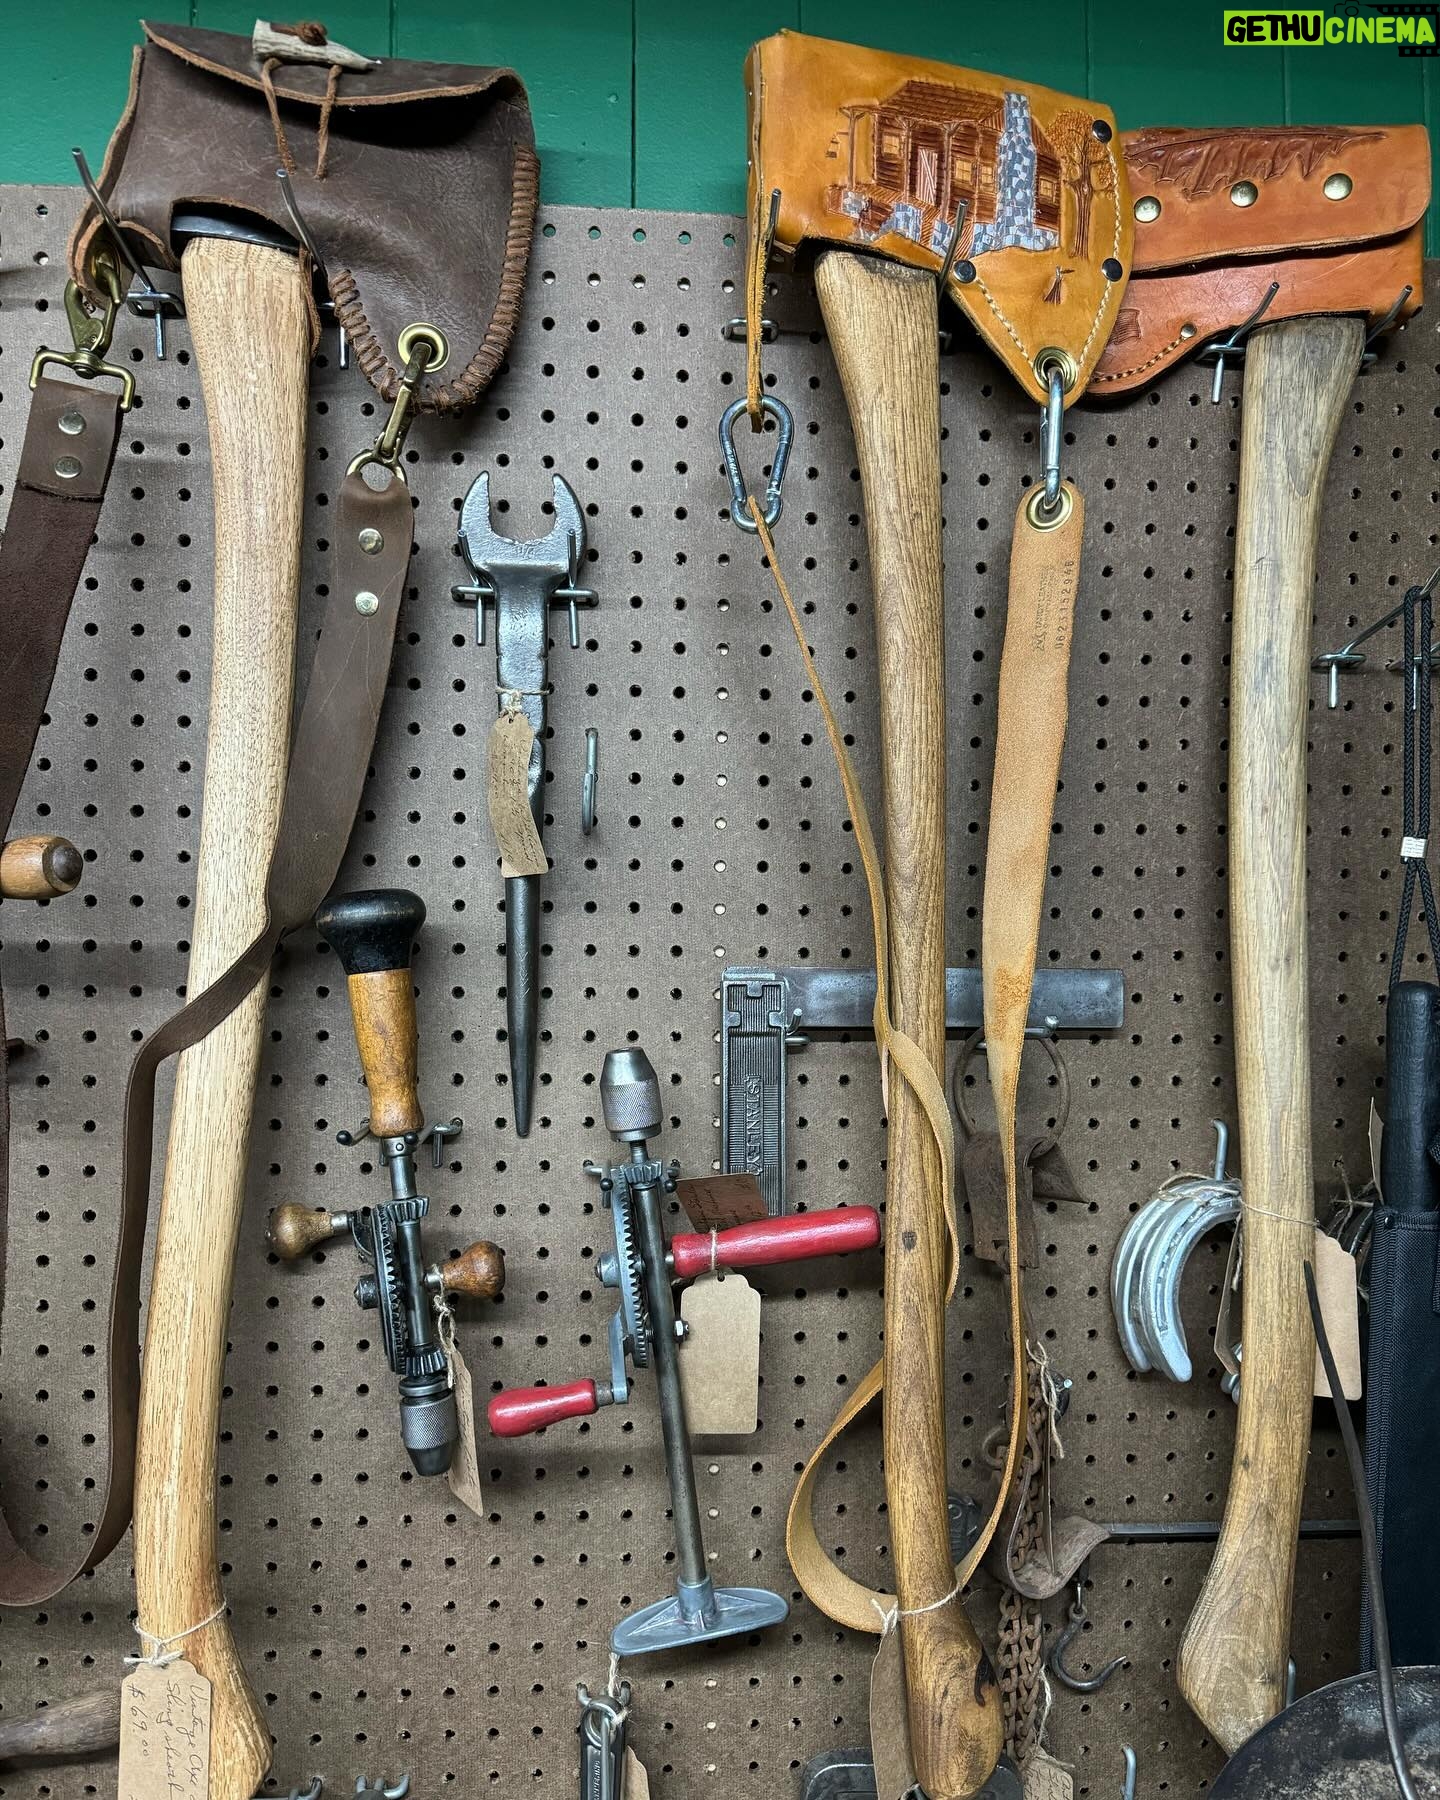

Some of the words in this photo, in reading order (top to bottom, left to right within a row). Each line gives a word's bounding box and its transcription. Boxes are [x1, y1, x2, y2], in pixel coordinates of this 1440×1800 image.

[746, 1081, 761, 1167] STANLEY
[156, 1680, 187, 1727] Sling
[175, 1684, 209, 1749] Vintage
[183, 1754, 204, 1787] Axe
